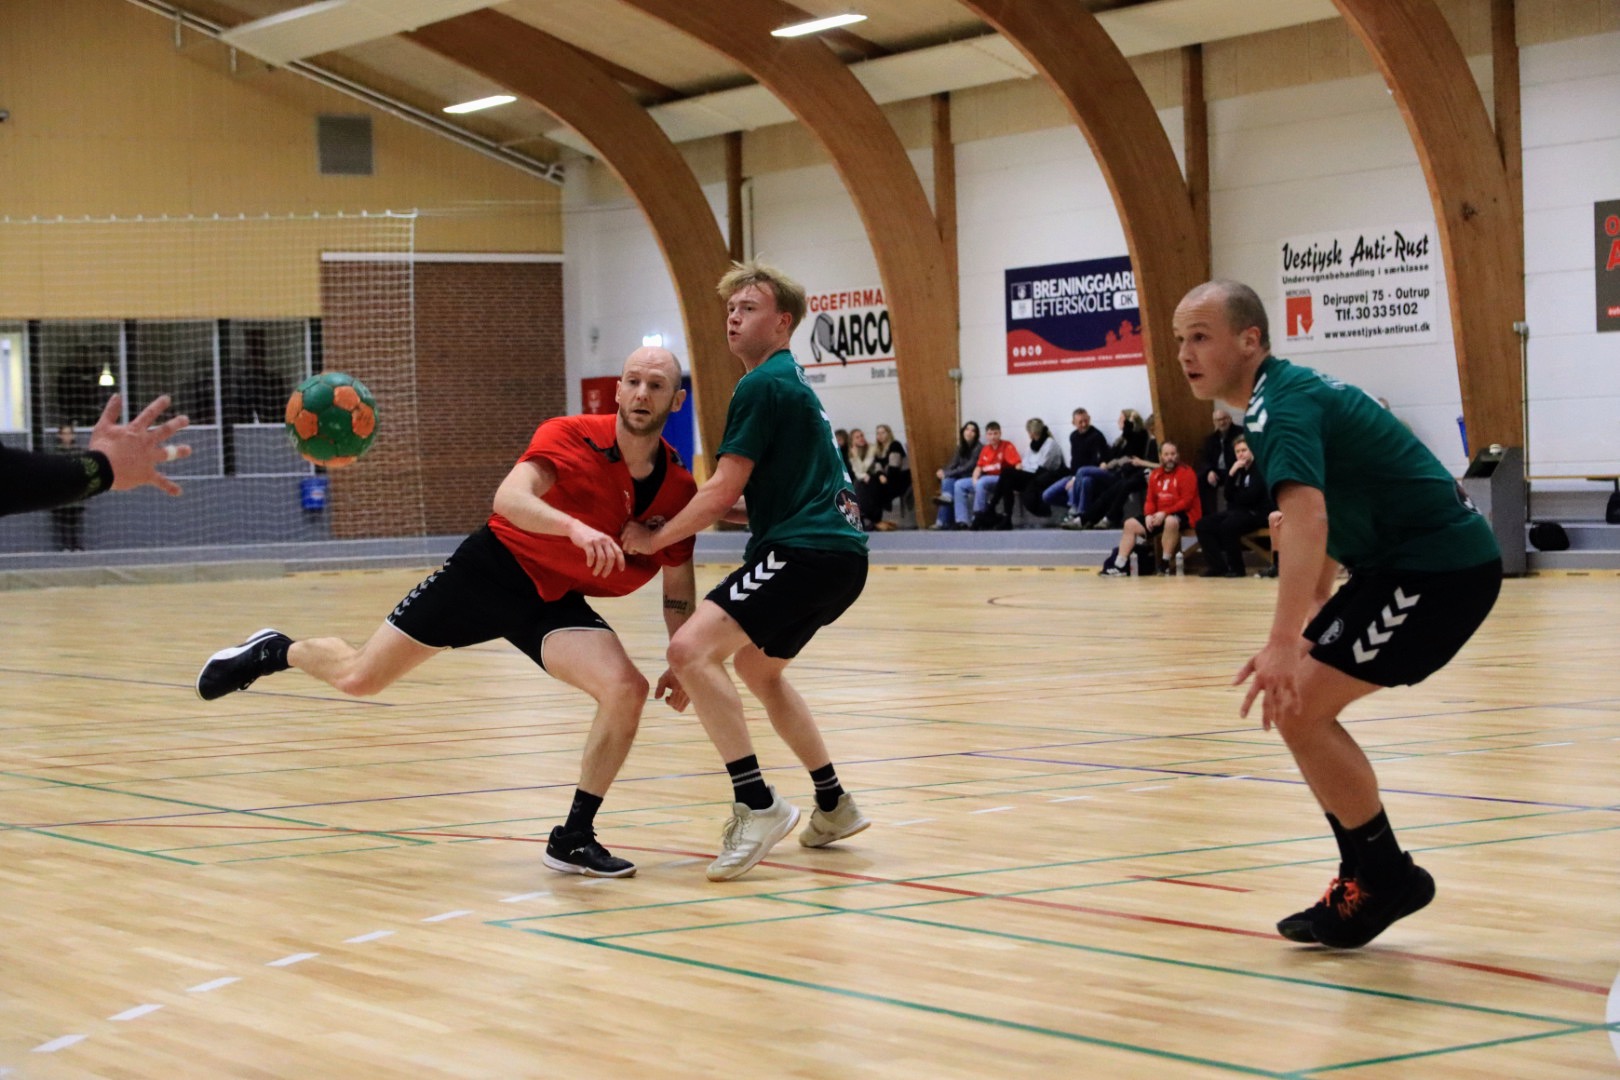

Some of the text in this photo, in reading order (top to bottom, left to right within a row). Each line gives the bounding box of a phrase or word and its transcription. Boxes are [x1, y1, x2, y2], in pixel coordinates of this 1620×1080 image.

[1282, 230, 1429, 273] Vestjysk Anti-Rust
[1282, 268, 1375, 284] Undervognsbehandling
[1384, 263, 1429, 275] særklasse
[806, 288, 884, 312] GGEFIRMA
[1034, 293, 1112, 318] EFTERSKOLE
[1323, 287, 1430, 307] Dejrupvej 75 Outrup
[1335, 308, 1354, 321] Tlf.
[1324, 321, 1430, 339] www.vestjysk-antirust.dk
